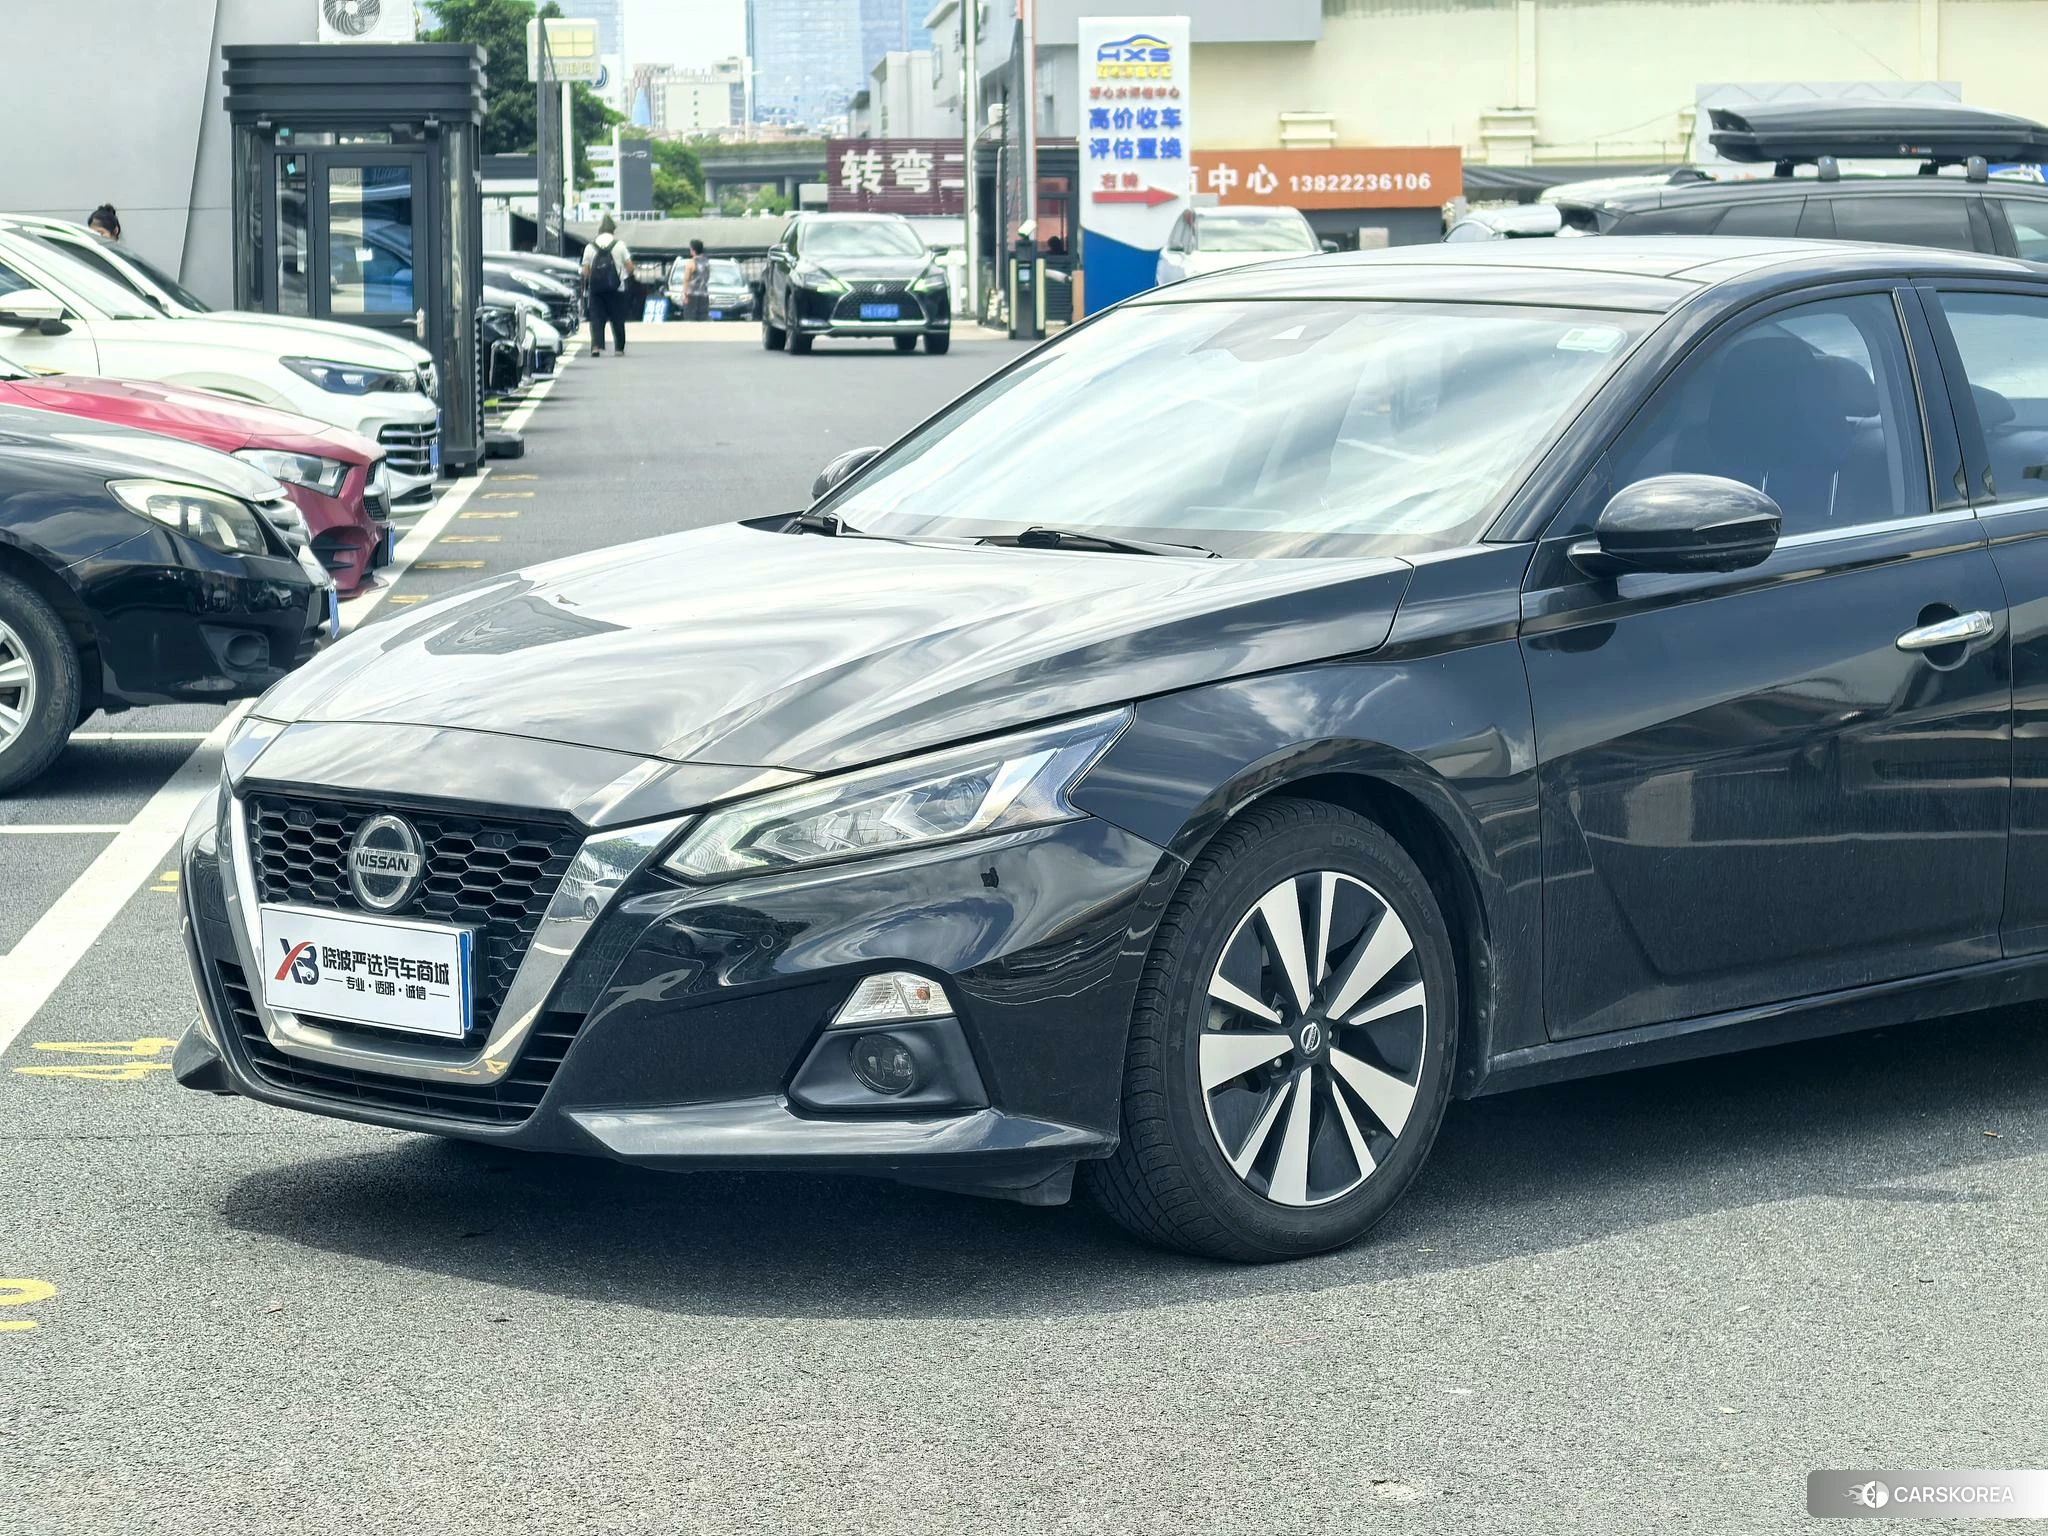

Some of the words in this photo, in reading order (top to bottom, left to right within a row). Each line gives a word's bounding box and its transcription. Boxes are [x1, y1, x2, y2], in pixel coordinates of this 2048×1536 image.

[1097, 48, 1170, 62] HXS
[1089, 107, 1182, 129] 高价收车
[1089, 137, 1182, 159] 评估置换
[1289, 173, 1432, 192] 13822236106
[355, 852, 409, 871] NISSAN
[322, 946, 450, 985] 晓波严选汽车商城
